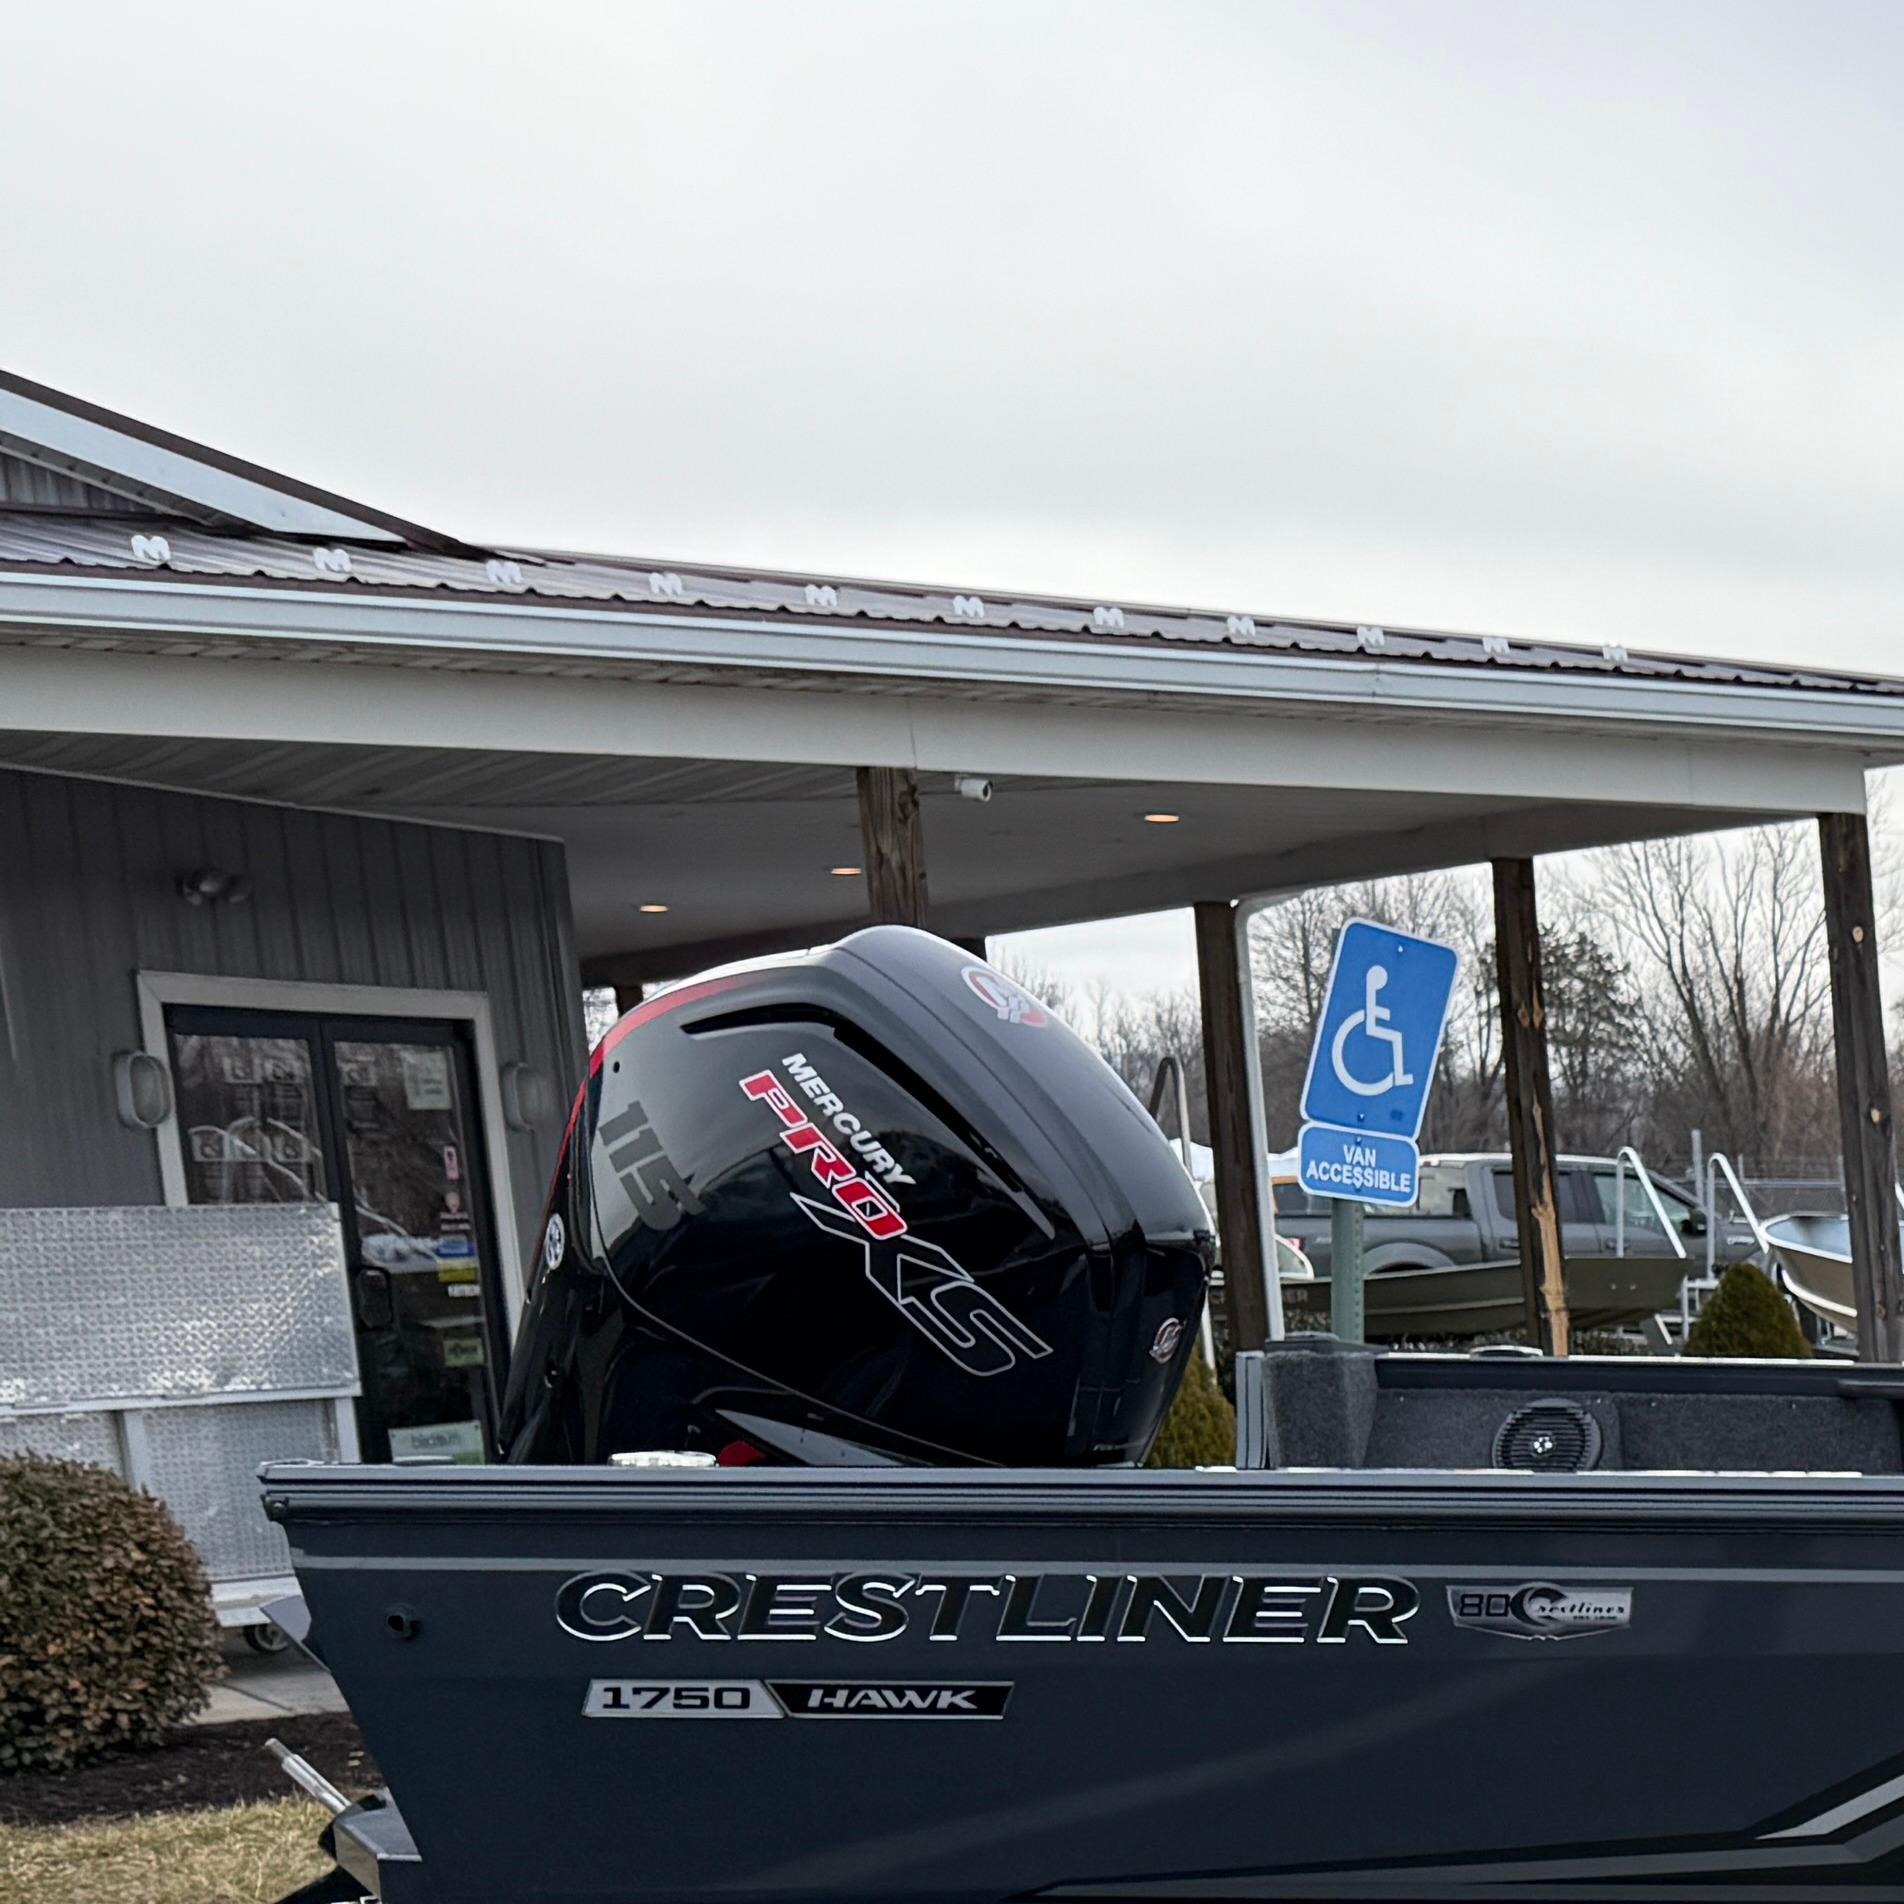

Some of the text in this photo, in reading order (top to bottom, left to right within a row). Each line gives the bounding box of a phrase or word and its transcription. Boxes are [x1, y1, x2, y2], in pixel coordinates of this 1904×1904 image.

[599, 1100, 703, 1231] 115
[739, 1069, 908, 1240] PRO
[782, 1053, 916, 1185] MERCURY
[1343, 1144, 1376, 1168] VAN
[1306, 1160, 1411, 1193] ACCESSIBLE
[790, 1171, 1053, 1376] XS
[556, 1570, 1421, 1644] CRESTLINER
[602, 1686, 978, 1710] 1750 HAWK
